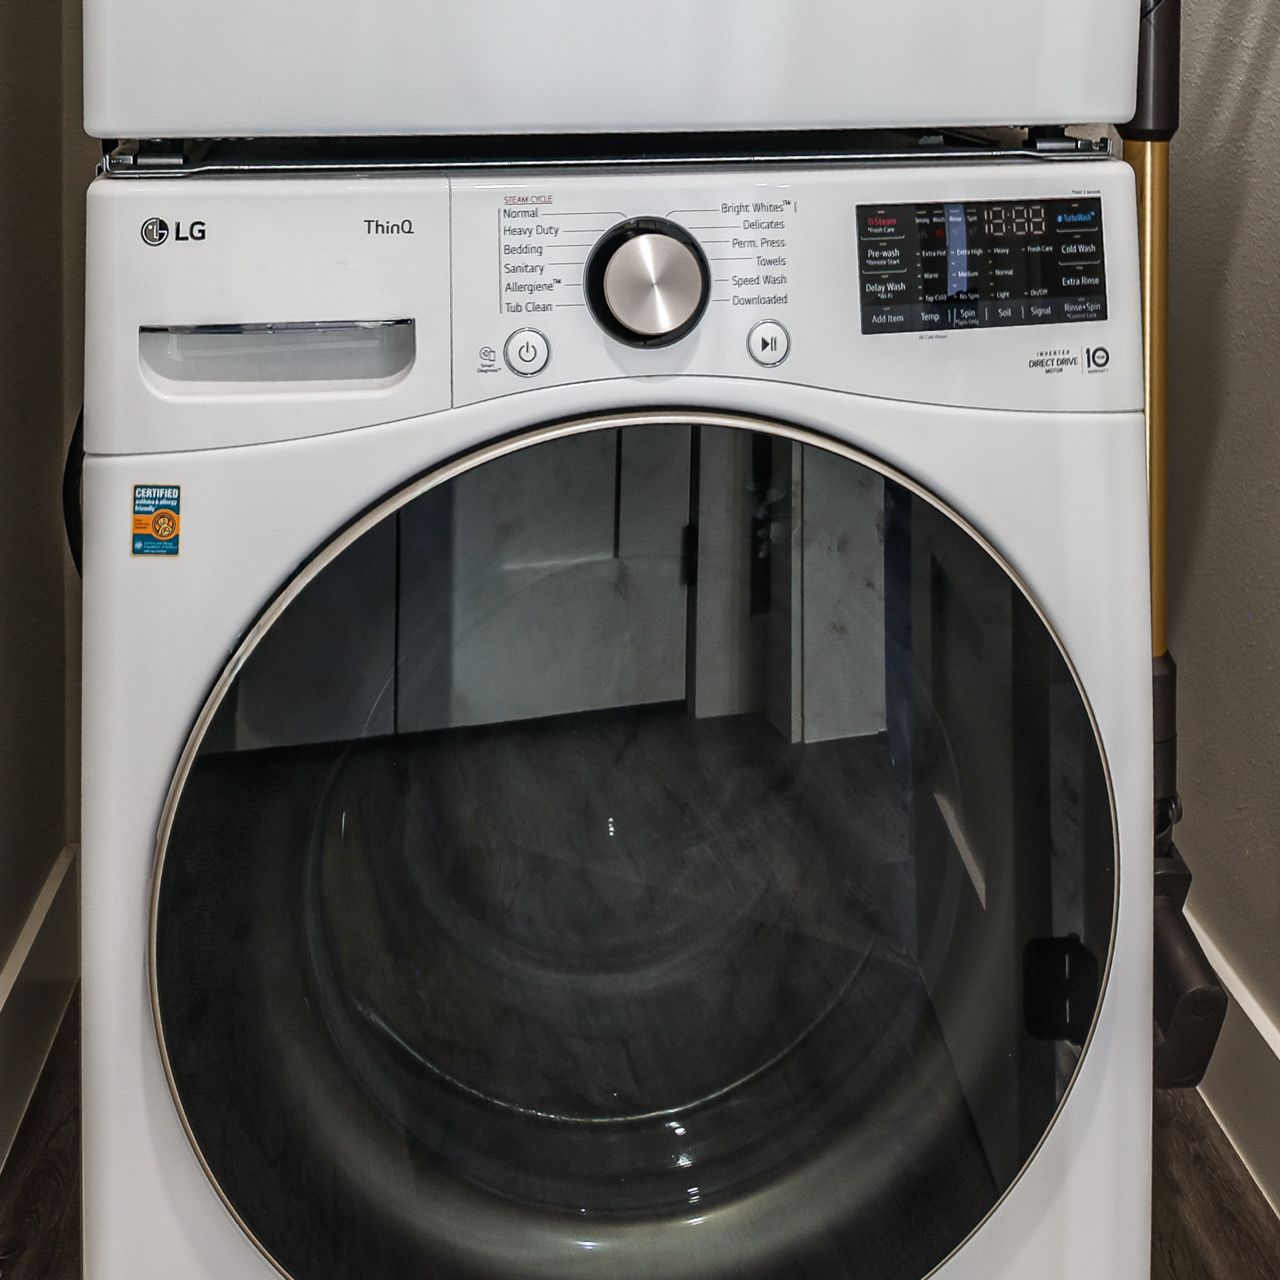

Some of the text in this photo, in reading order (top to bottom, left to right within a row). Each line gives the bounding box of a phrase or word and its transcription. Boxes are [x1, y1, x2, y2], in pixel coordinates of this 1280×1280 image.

[504, 195, 552, 204] STEAM CYCLE
[504, 208, 538, 218] Normal
[721, 202, 750, 216] Bright
[364, 220, 414, 234] ThinQ
[743, 220, 785, 230] Delicates
[874, 218, 897, 226] Steam
[175, 221, 206, 241] LG
[504, 224, 560, 238] Heavy Duty
[732, 238, 786, 248] Perm. Press
[504, 244, 543, 256] Bedding
[868, 248, 900, 258] Pre-wash
[1061, 244, 1096, 254] Cold Wash
[756, 256, 786, 266] Towels
[504, 263, 544, 275] Sanitary
[732, 274, 788, 288] Speed Wash
[1062, 276, 1099, 286] Extra Rinse
[866, 282, 906, 293] Delay Wash
[732, 294, 788, 306] Downloaded
[505, 302, 552, 312] Tub Clean
[1030, 306, 1051, 317] Signal
[921, 312, 940, 322] Temp
[960, 308, 976, 319] Spin
[998, 308, 1012, 317] Soil
[872, 314, 904, 324] Add Item
[1036, 349, 1071, 358] INVERTER
[1085, 346, 1110, 368] 10
[1028, 356, 1078, 369] DIRECT DRIVE
[136, 488, 178, 498] CERTIFIED
